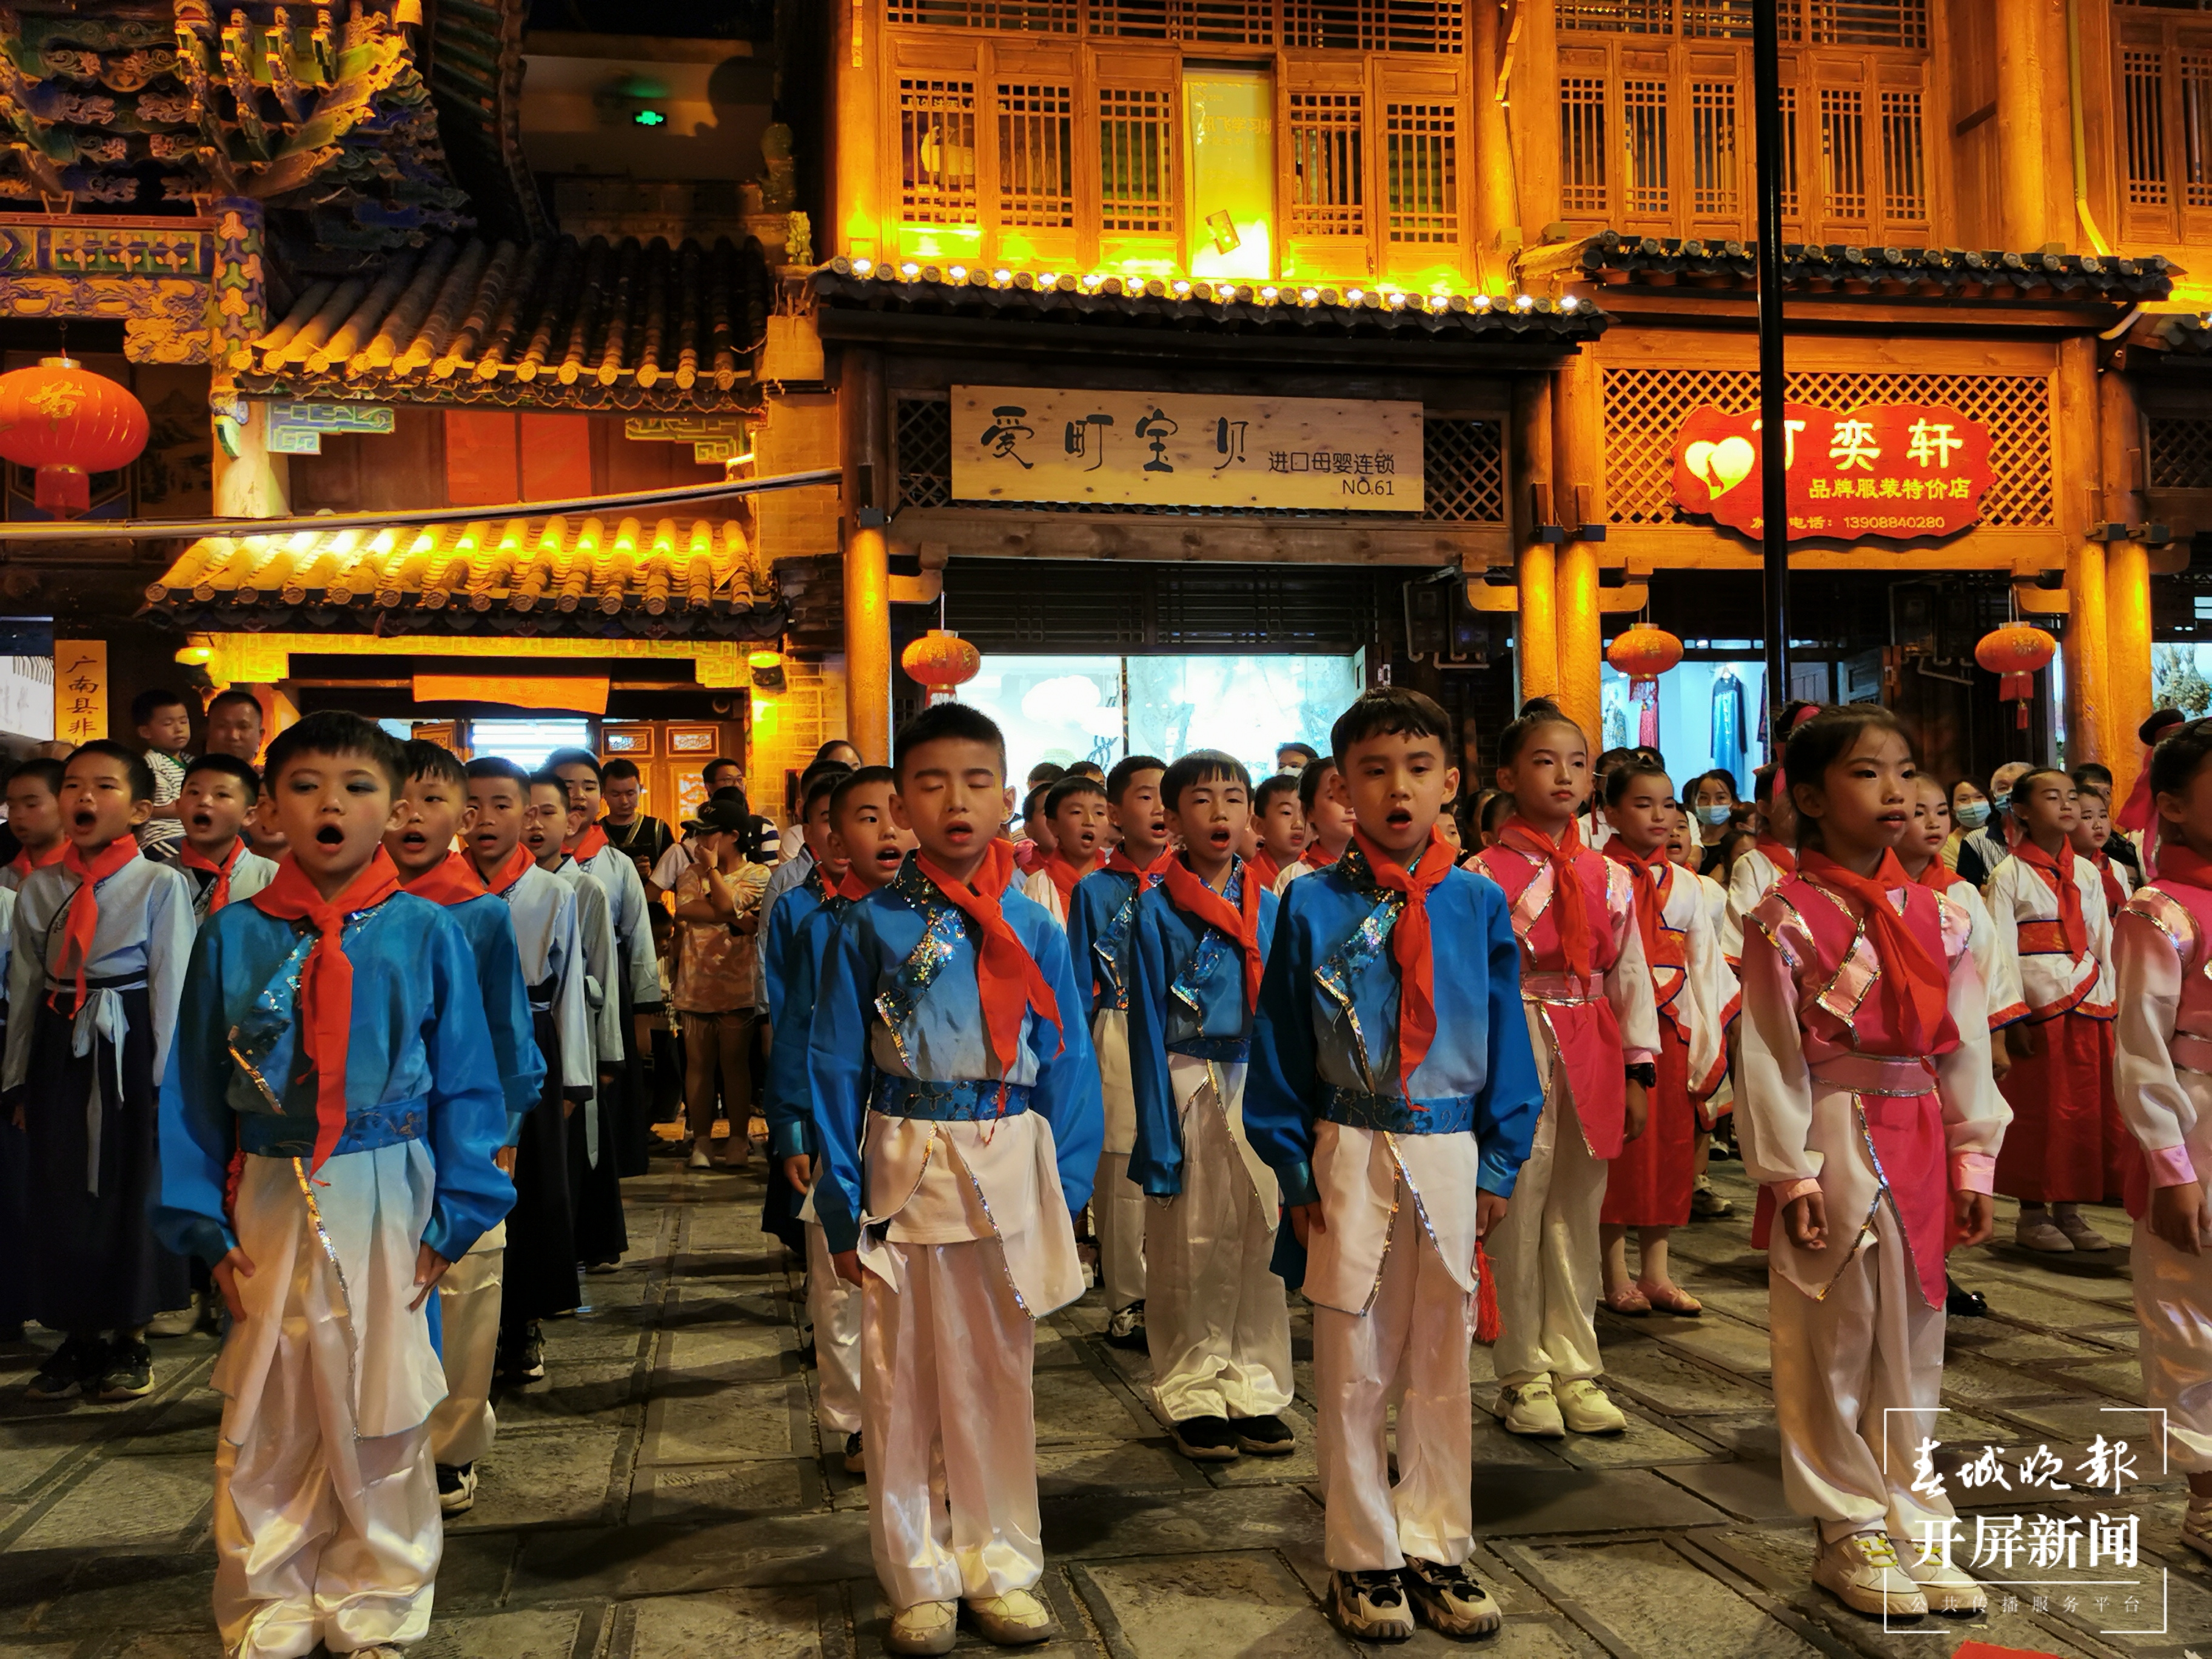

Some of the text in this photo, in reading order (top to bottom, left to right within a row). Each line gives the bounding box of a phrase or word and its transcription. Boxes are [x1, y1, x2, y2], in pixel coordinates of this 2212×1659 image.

[1267, 451, 1395, 475] 进口母婴连锁
[1342, 478, 1395, 496] NO.61
[1808, 478, 1971, 500] 品牌服装特价店
[65, 655, 99, 748] 广南县非
